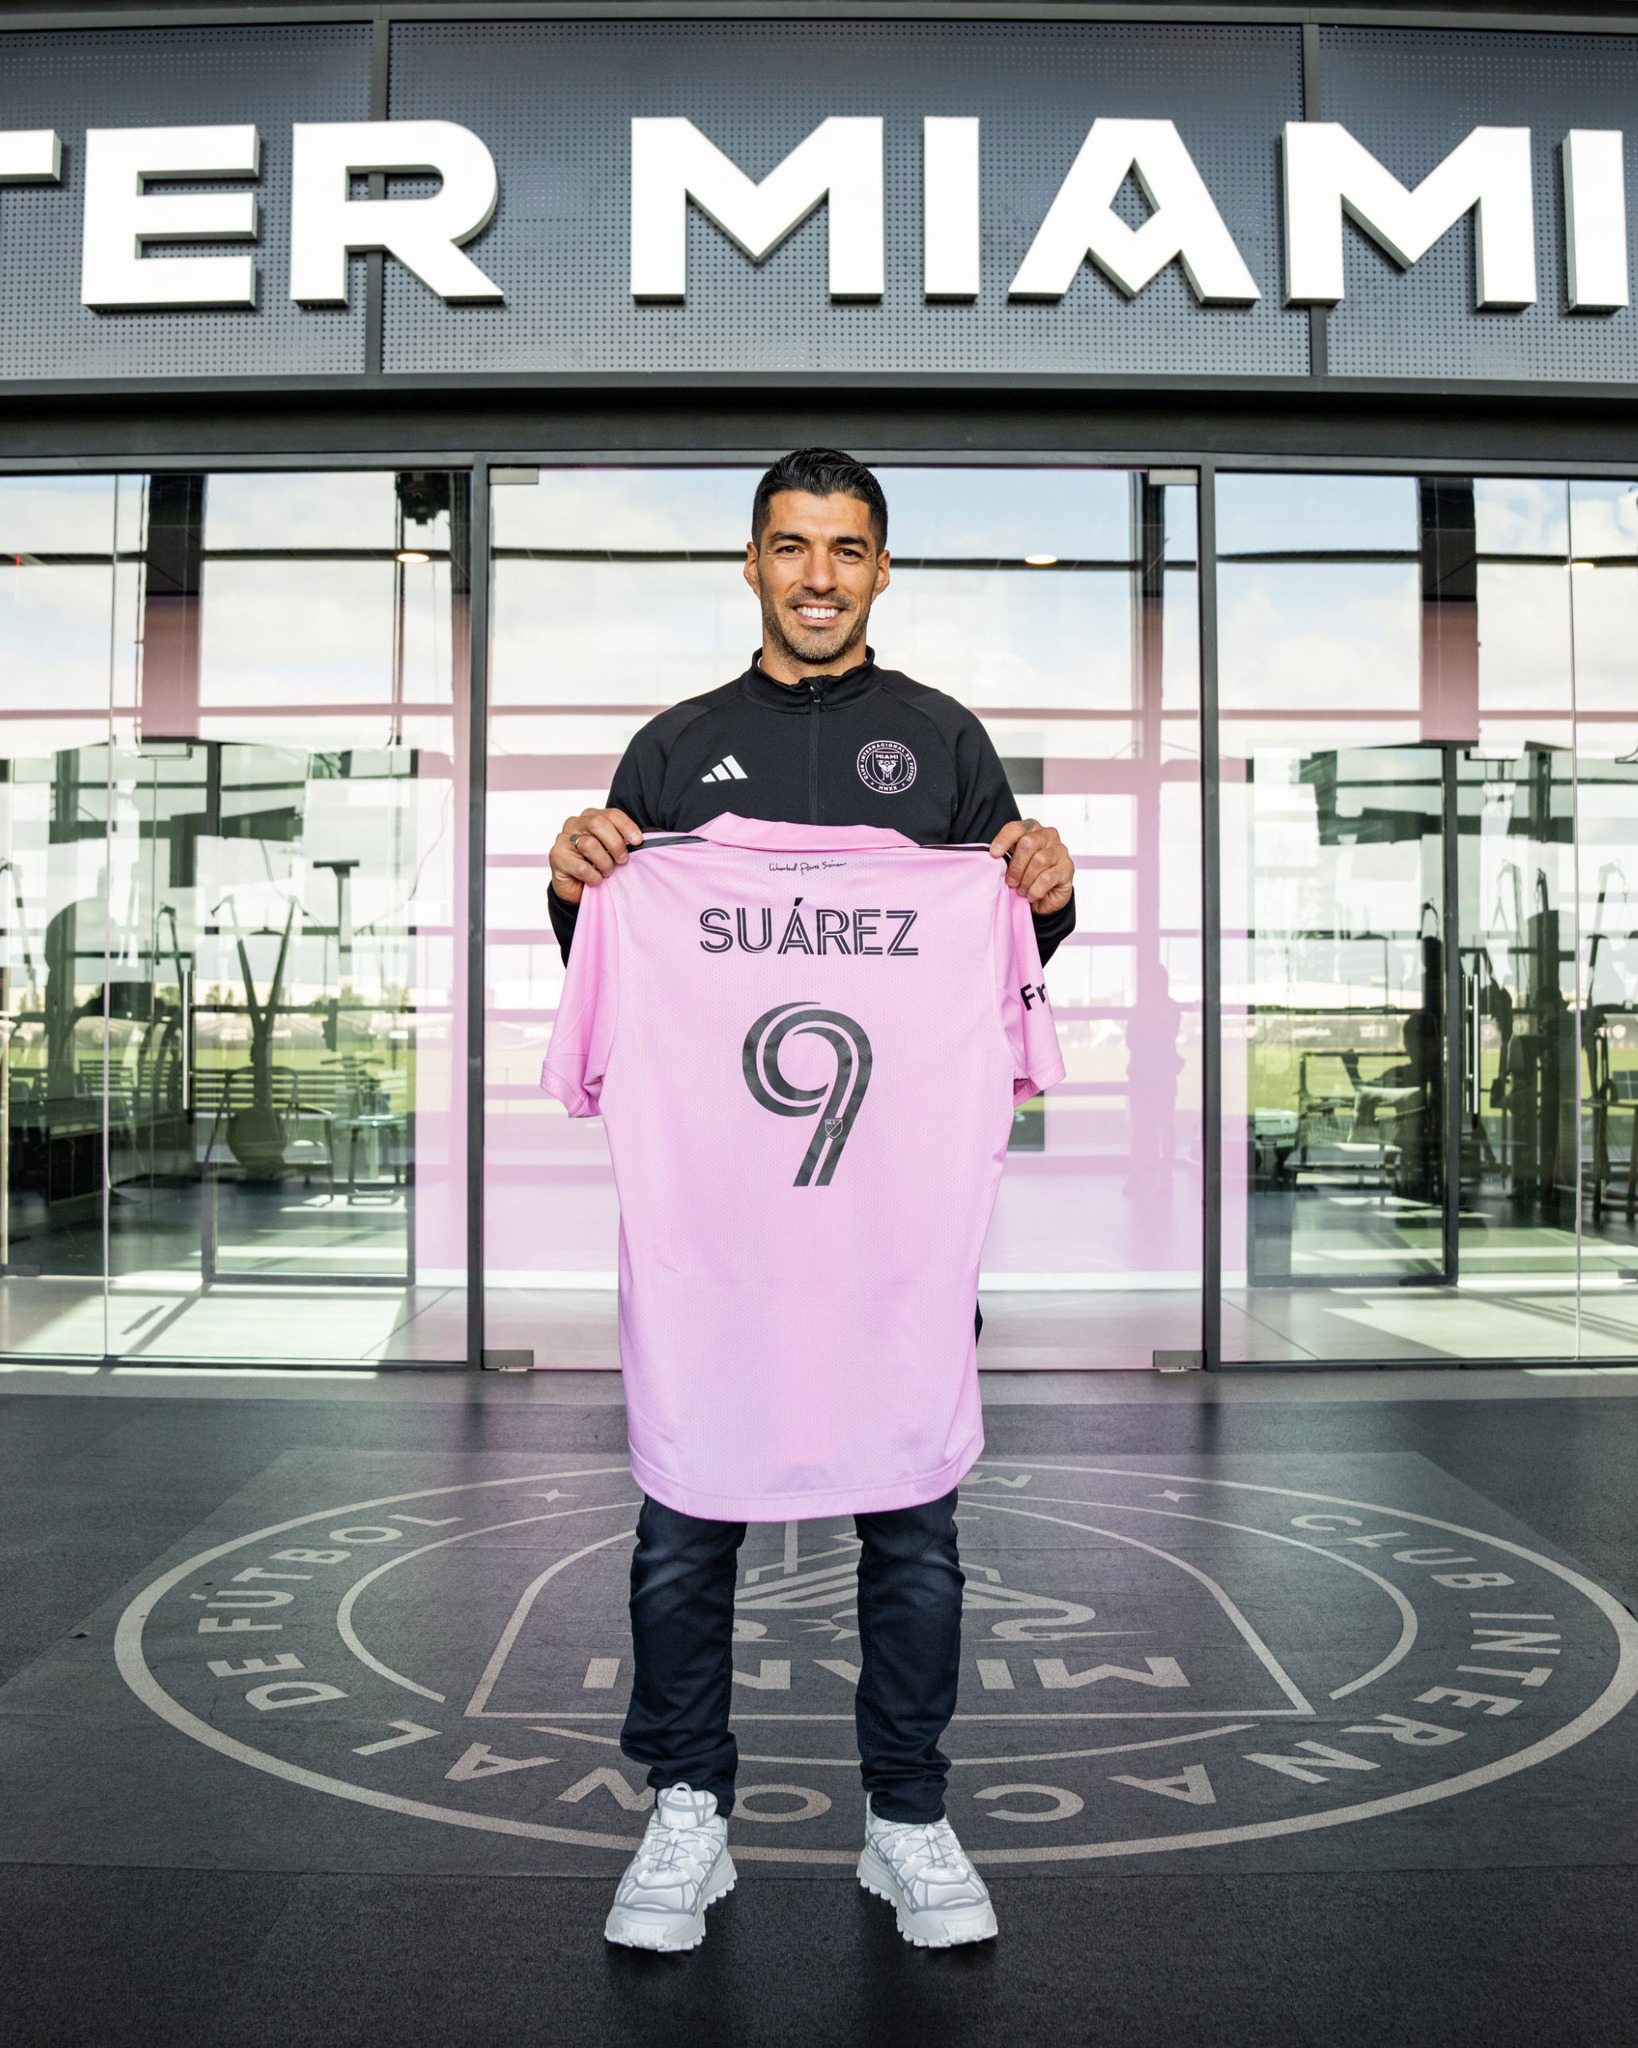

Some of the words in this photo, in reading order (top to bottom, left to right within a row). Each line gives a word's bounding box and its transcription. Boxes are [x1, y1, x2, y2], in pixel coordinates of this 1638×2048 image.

[631, 116, 1628, 312] MIAMI
[860, 764, 869, 780] CLUB
[905, 753, 912, 761] DE
[700, 897, 919, 956] SUÁREZ
[742, 1001, 873, 1187] 9
[190, 1513, 466, 1633] FÚTBOL
[1290, 1514, 1515, 1591] CLUB
[206, 1652, 350, 1711] DE
[352, 1612, 1562, 1823] INTERNACONAL
